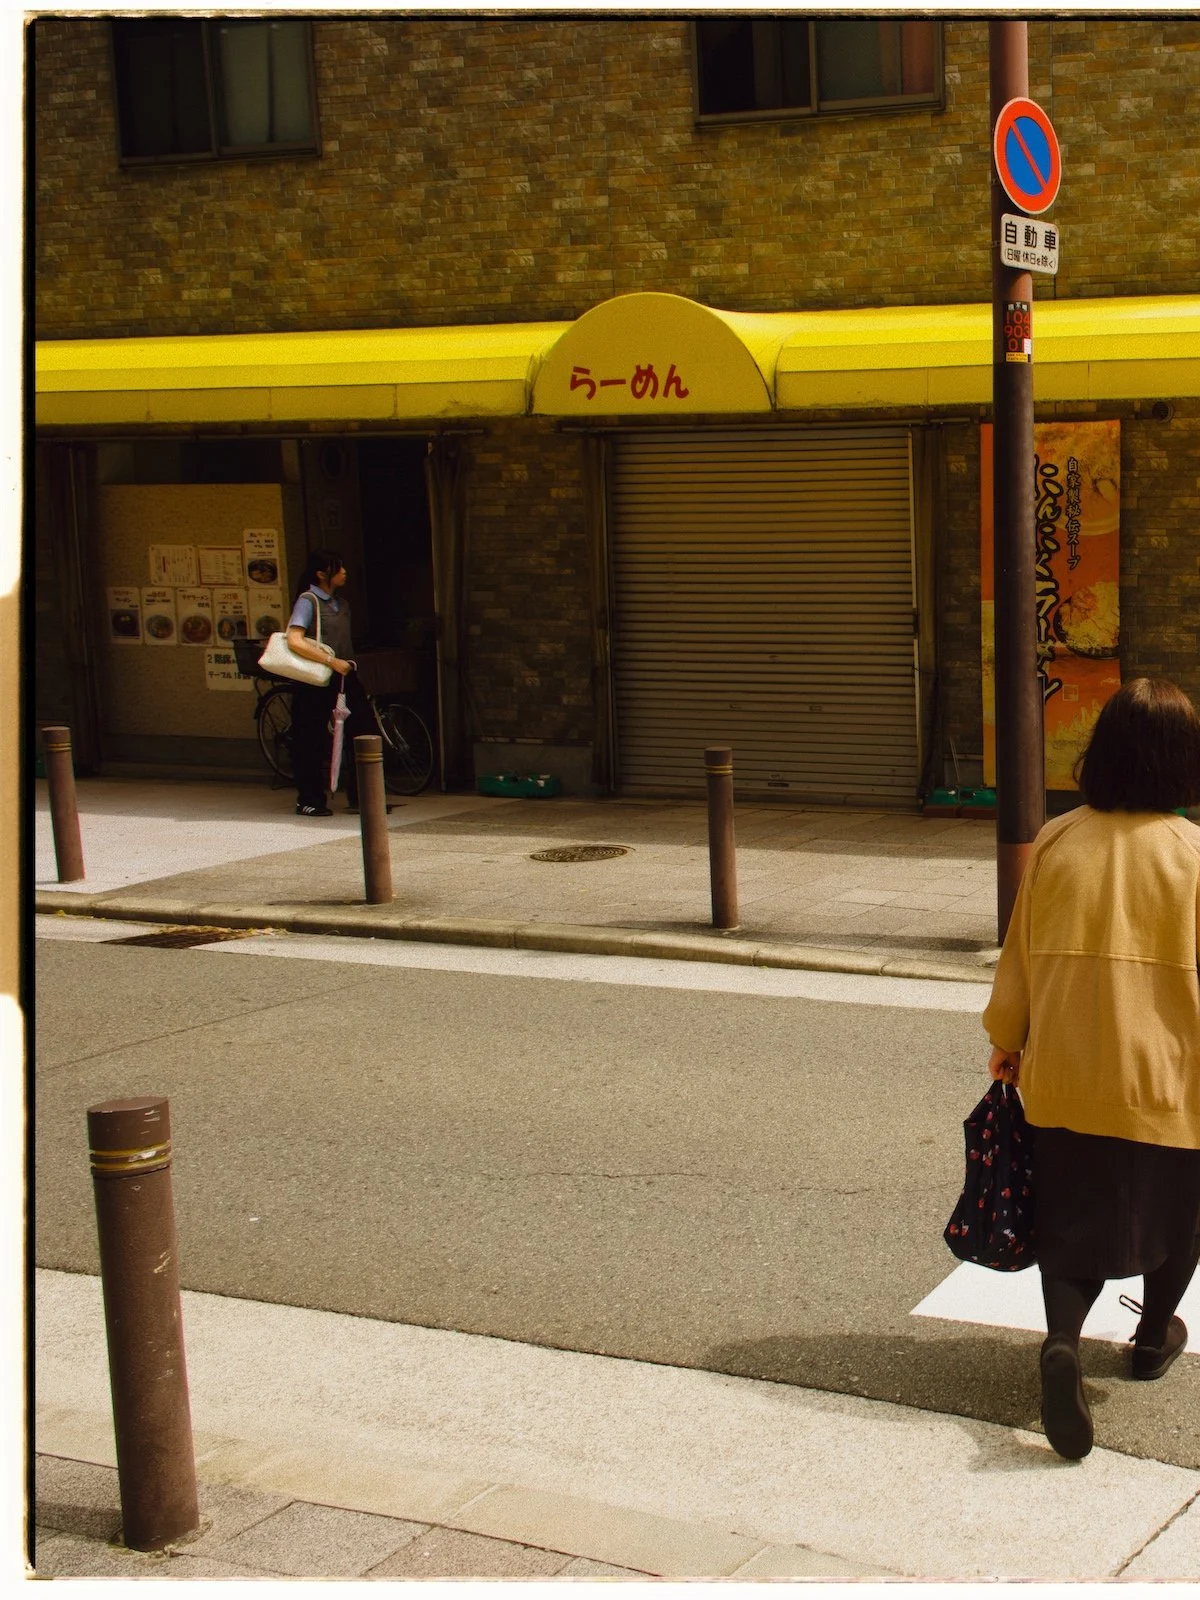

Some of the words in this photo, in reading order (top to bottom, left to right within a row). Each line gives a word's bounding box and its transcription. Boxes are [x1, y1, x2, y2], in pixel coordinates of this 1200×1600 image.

[1005, 221, 1056, 252] 自動車
[570, 364, 690, 401] らーめん
[1065, 456, 1081, 571] 自家製秘伝スープ
